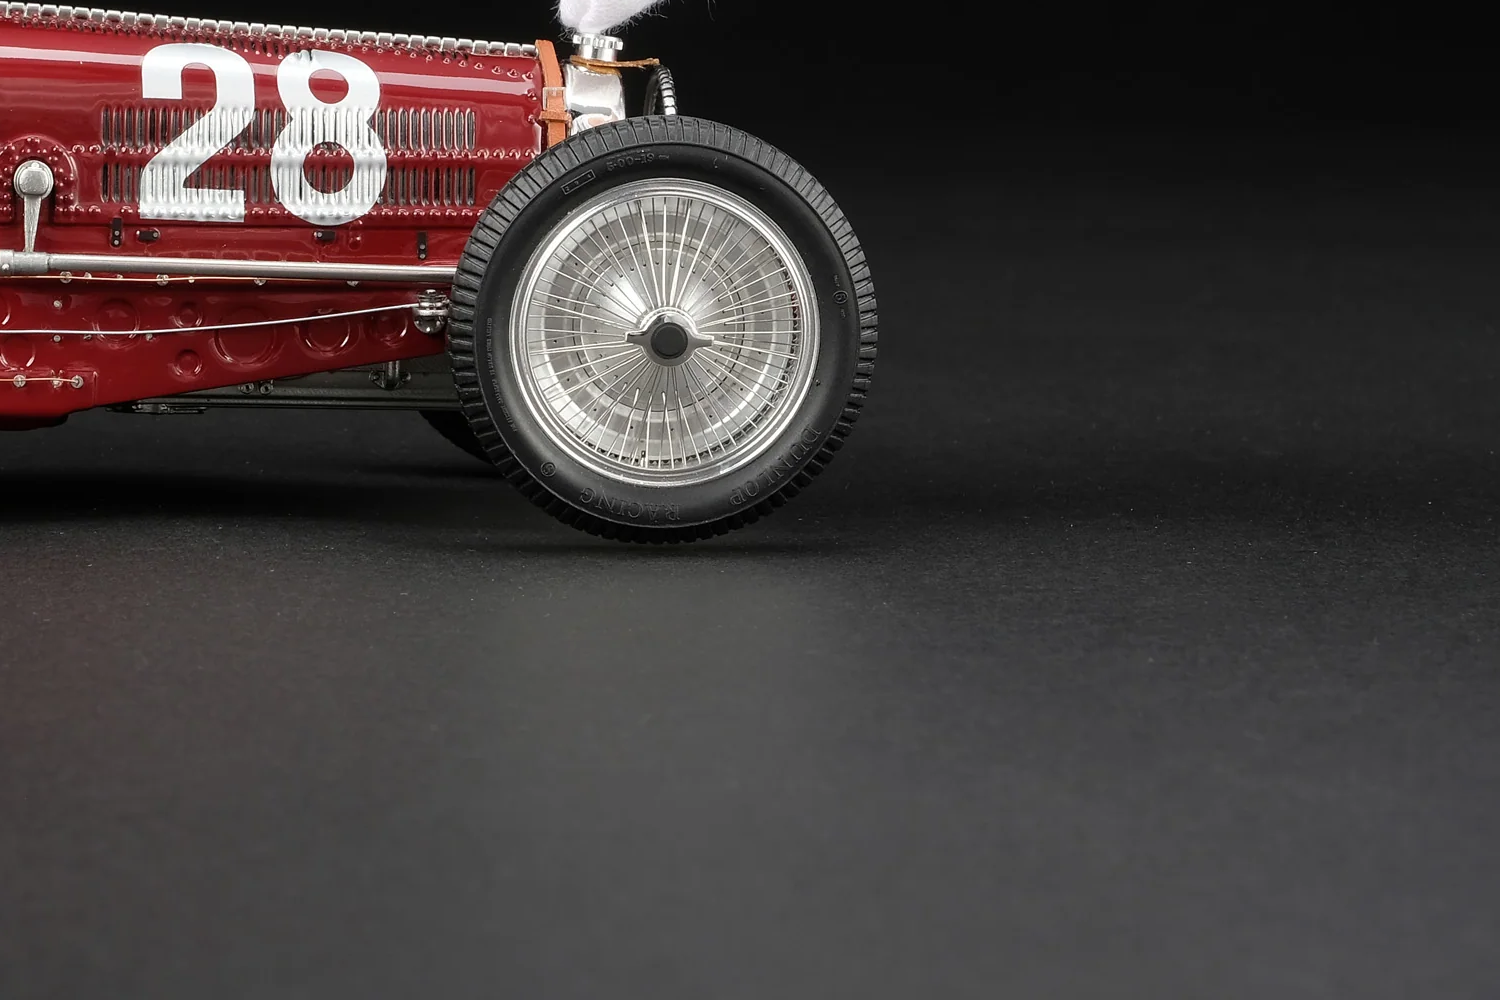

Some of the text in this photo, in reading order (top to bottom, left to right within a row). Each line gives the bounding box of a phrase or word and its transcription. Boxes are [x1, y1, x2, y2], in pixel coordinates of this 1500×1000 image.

[140, 42, 387, 226] 28
[580, 426, 822, 521] DUNLOP RACING
